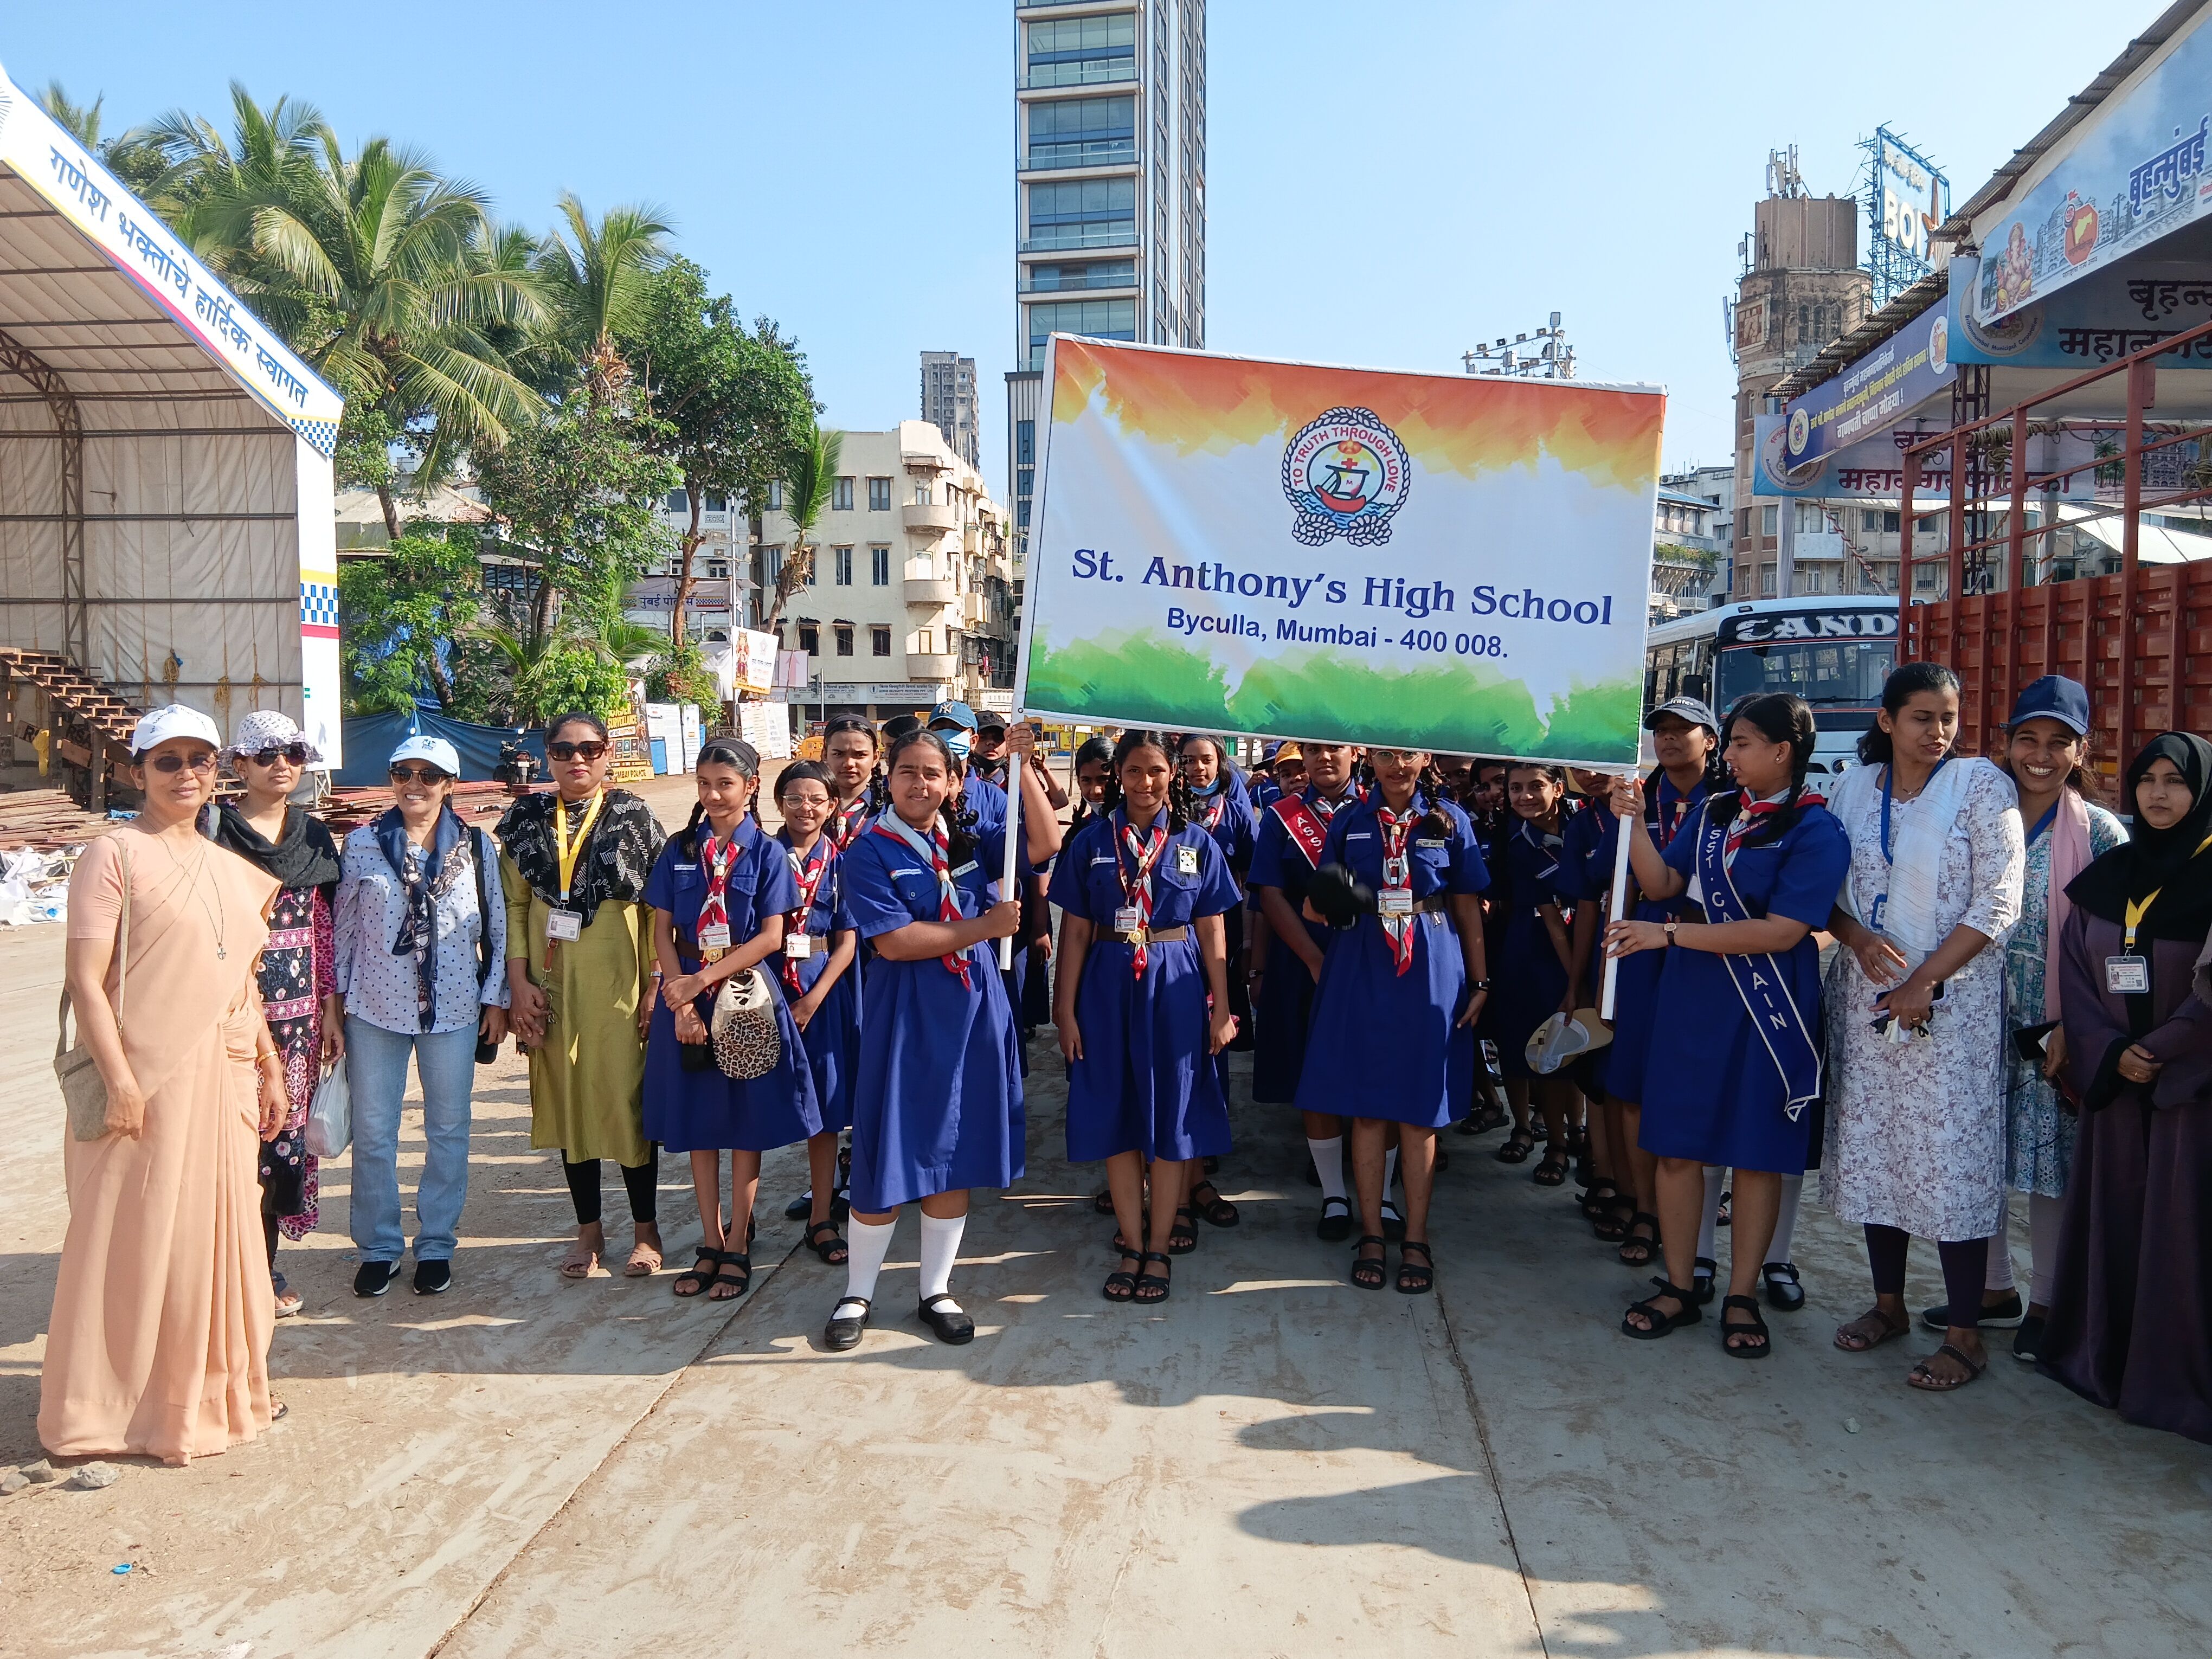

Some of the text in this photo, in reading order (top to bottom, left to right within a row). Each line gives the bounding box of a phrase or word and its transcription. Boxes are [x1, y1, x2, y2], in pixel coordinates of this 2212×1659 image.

[1883, 185, 1922, 256] BOI
[49, 145, 308, 408] गणेश भक्तांचे हार्दिक स्वागत
[1991, 343, 2017, 351] Municipal
[1837, 410, 1861, 438] गणपती
[1879, 390, 1900, 415] मोरया
[1293, 427, 1399, 493] TO TRUTH THROUGH LOVE
[1072, 548, 1612, 625] St. Anthony's High School
[1167, 607, 1268, 643] Byculla,
[1276, 619, 1377, 648] Mumbai
[1400, 628, 1446, 652] 400
[1455, 632, 1508, 659] 008.
[1736, 614, 1899, 641] SAND
[1297, 816, 1323, 853] ASS
[1712, 891, 1787, 1030] CATAIN
